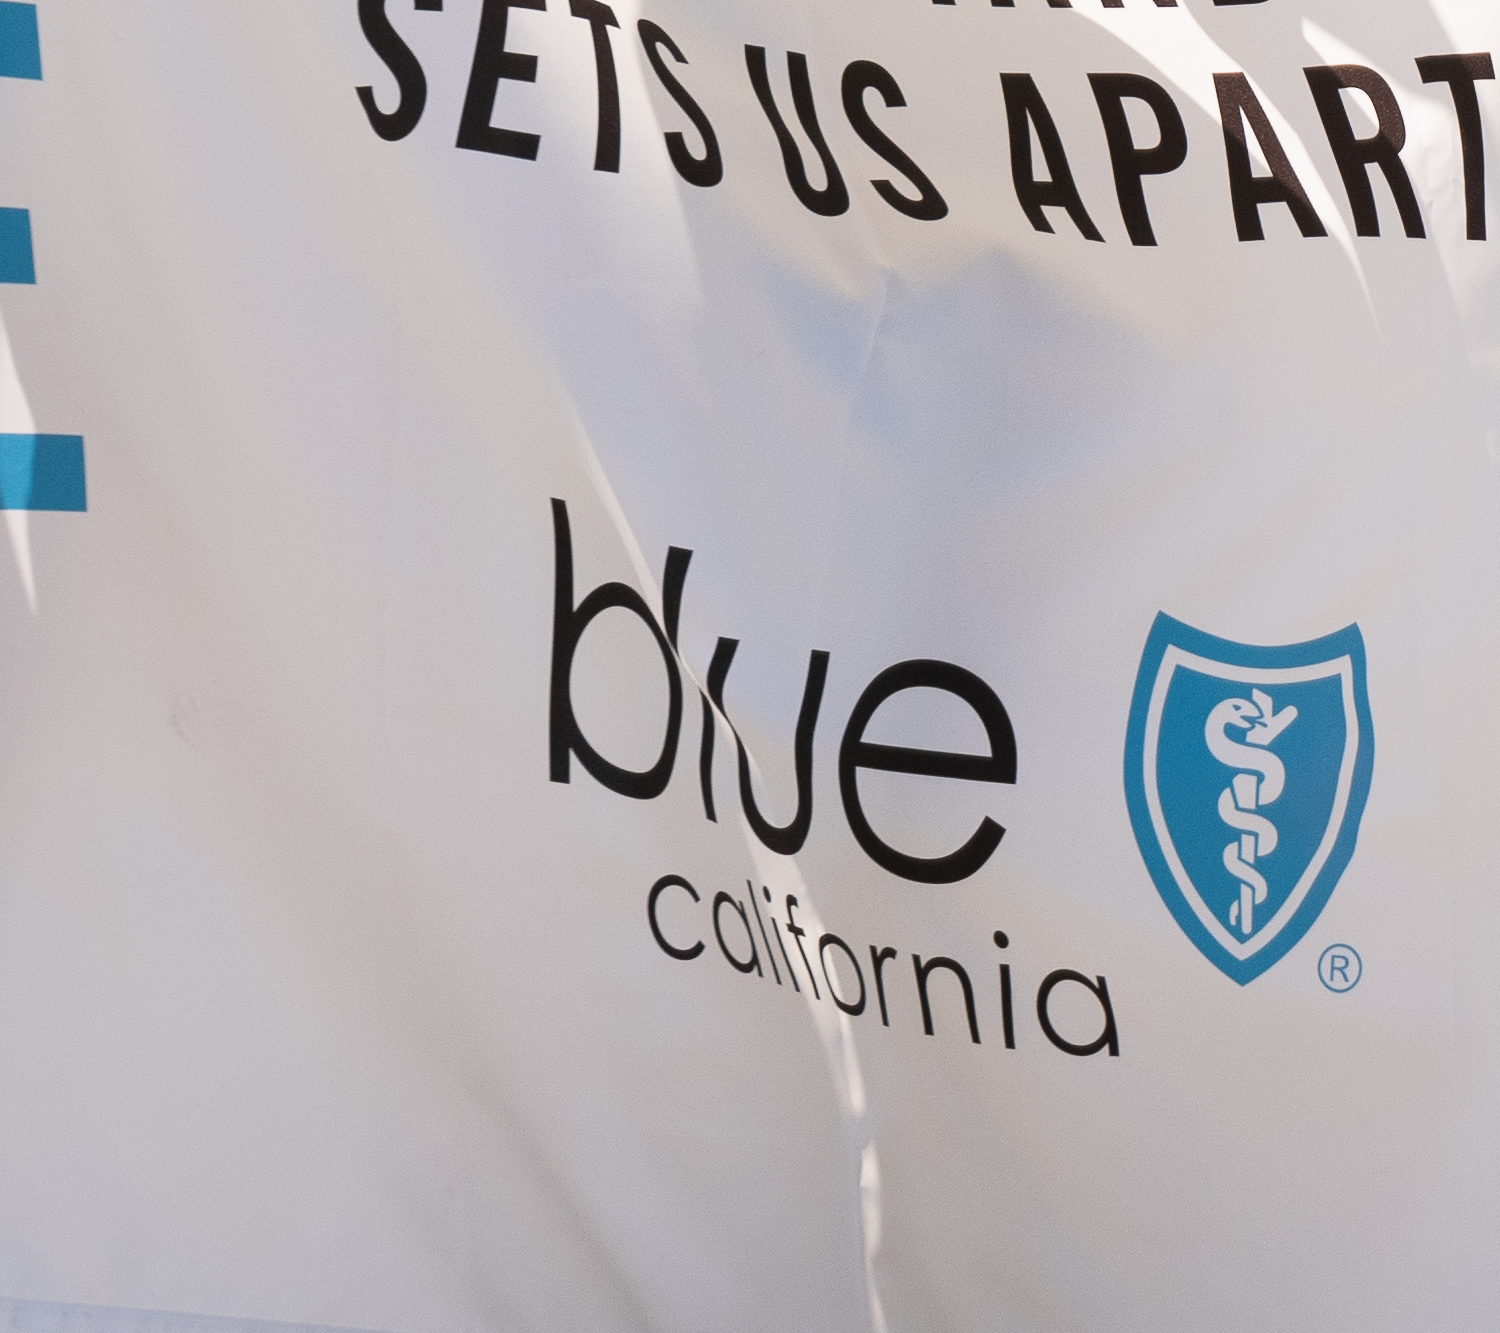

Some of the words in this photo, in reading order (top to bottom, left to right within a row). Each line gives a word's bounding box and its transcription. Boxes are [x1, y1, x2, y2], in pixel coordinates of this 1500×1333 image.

[744, 44, 949, 222] US
[999, 53, 1497, 247] APART
[549, 497, 1019, 885] blue
[646, 873, 1121, 1058] california
